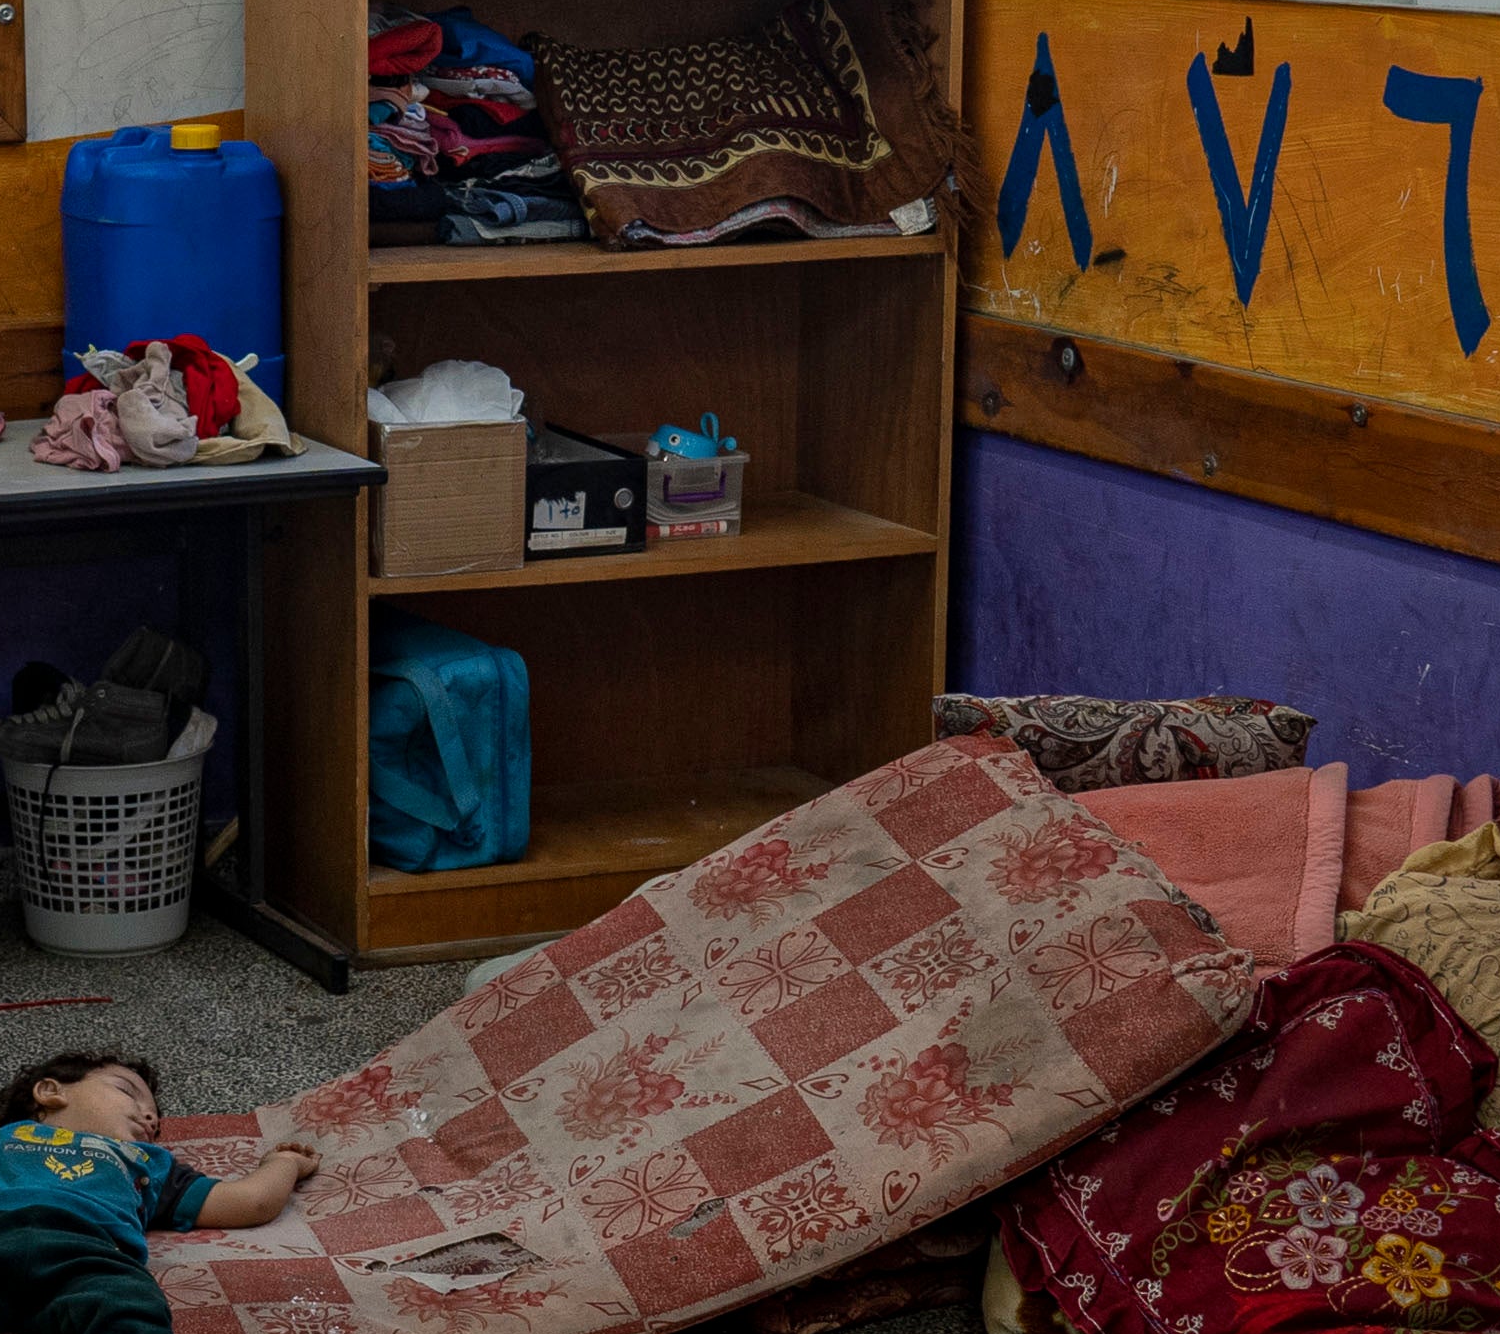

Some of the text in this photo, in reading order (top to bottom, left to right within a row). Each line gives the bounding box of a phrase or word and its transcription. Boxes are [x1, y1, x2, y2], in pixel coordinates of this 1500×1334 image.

[998, 33, 1092, 270] ٨
[1188, 53, 1291, 307] ٧
[1384, 65, 1489, 356] ٦
[5, 1144, 76, 1155] FASHION
